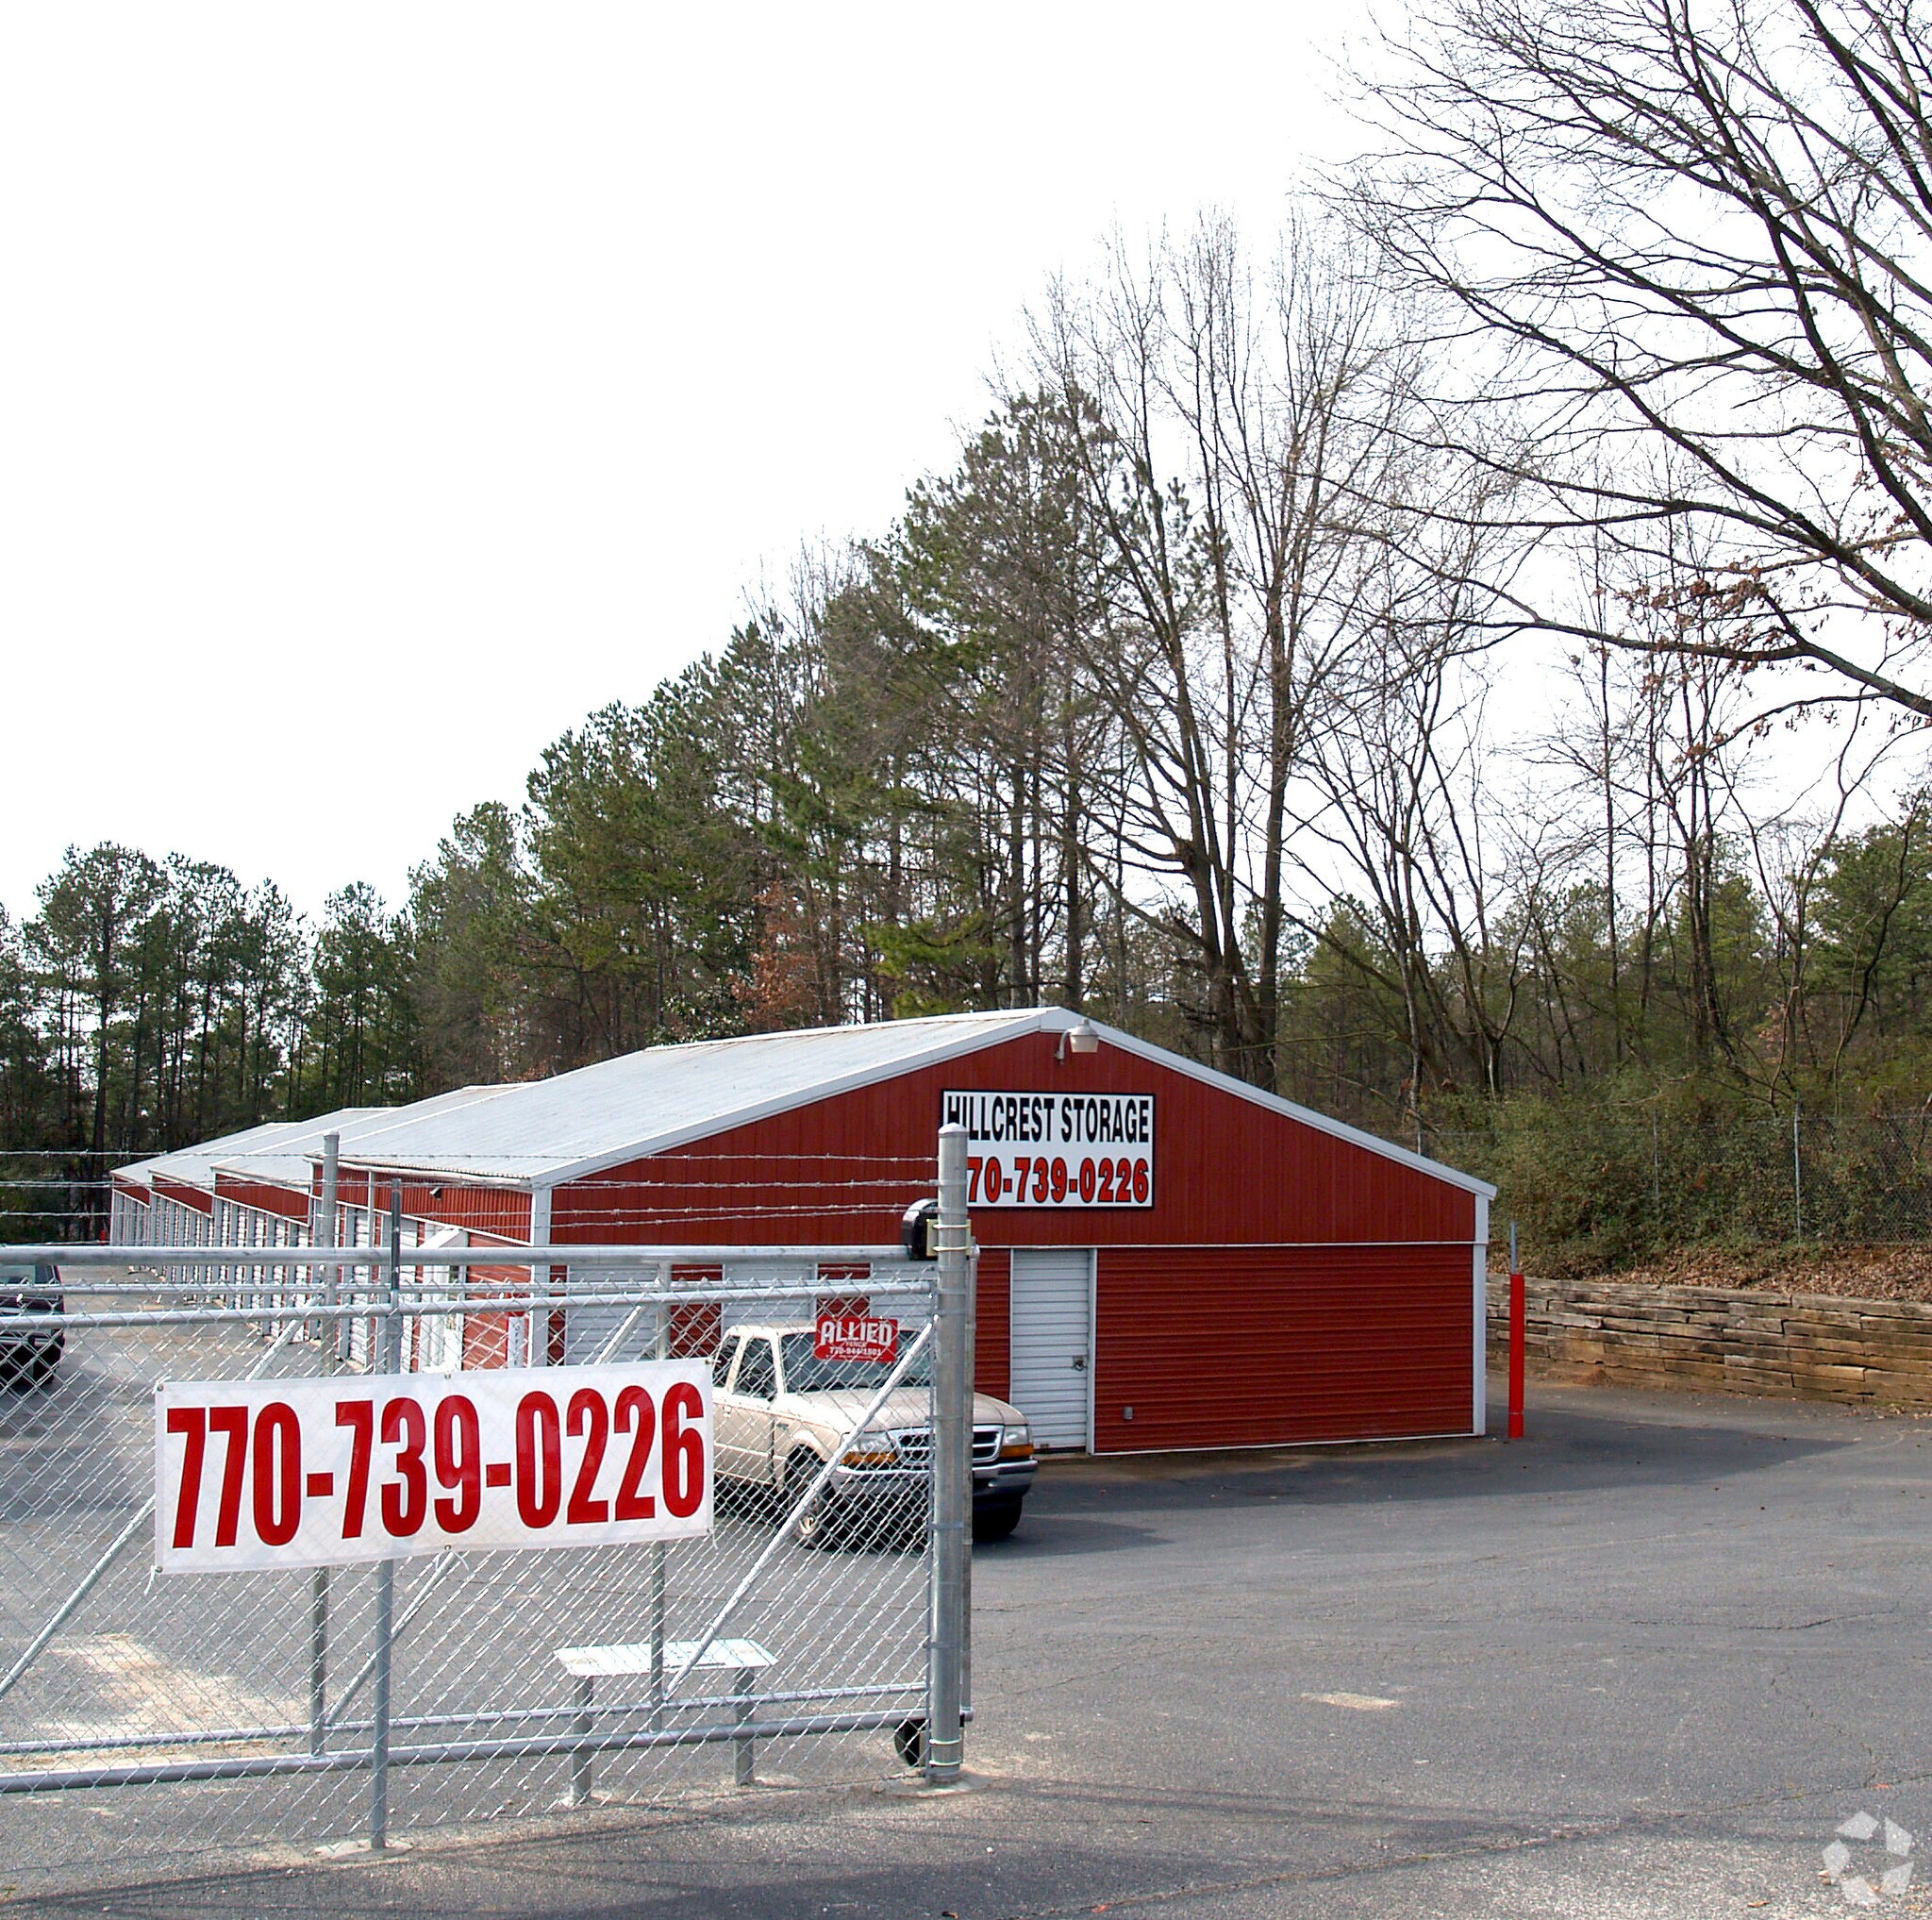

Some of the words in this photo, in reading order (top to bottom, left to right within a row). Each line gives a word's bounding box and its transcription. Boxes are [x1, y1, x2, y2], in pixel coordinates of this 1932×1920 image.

[947, 1095, 1055, 1142] HILLCREST
[1060, 1096, 1149, 1144] STORAGE
[967, 1156, 1149, 1204] 70-739-0226
[820, 1321, 893, 1347] ALLIED
[167, 1382, 705, 1548] 770-739-0226
